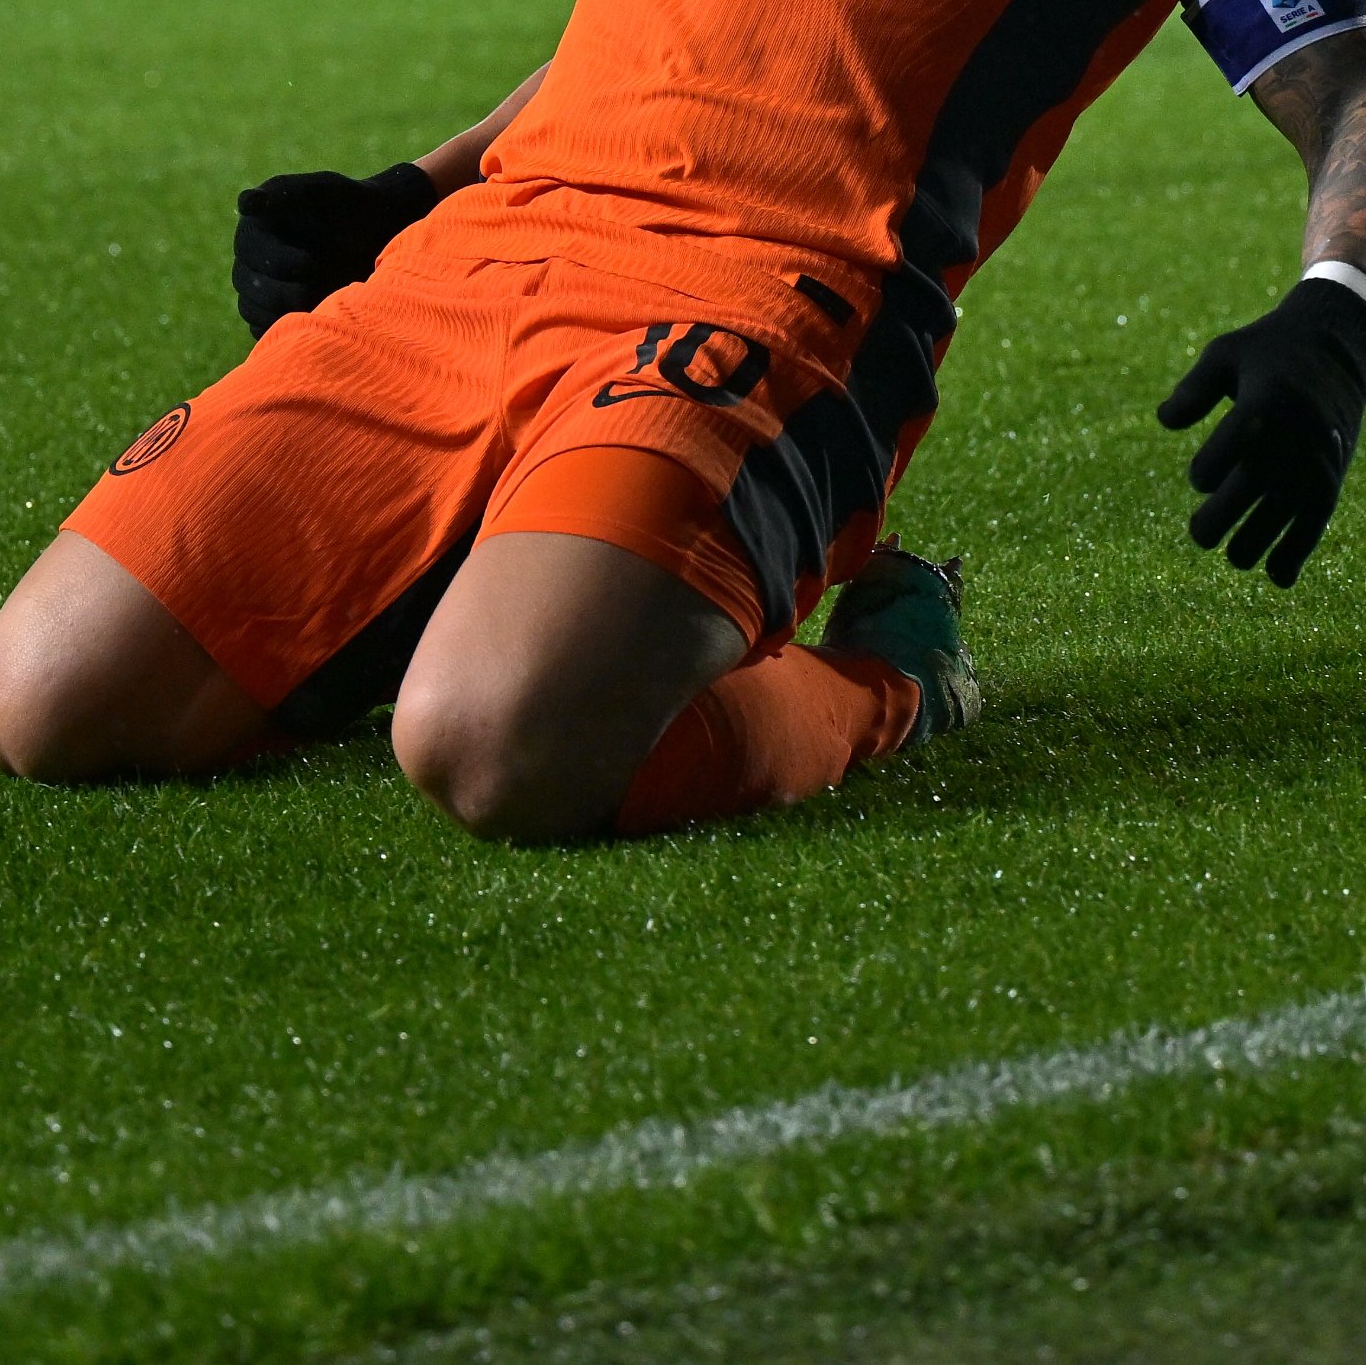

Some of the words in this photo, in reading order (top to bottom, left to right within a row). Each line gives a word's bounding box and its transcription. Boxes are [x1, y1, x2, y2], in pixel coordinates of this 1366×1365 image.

[1280, 8, 1307, 24] SERIE
[1307, 4, 1316, 14] A
[627, 322, 771, 407] 10
